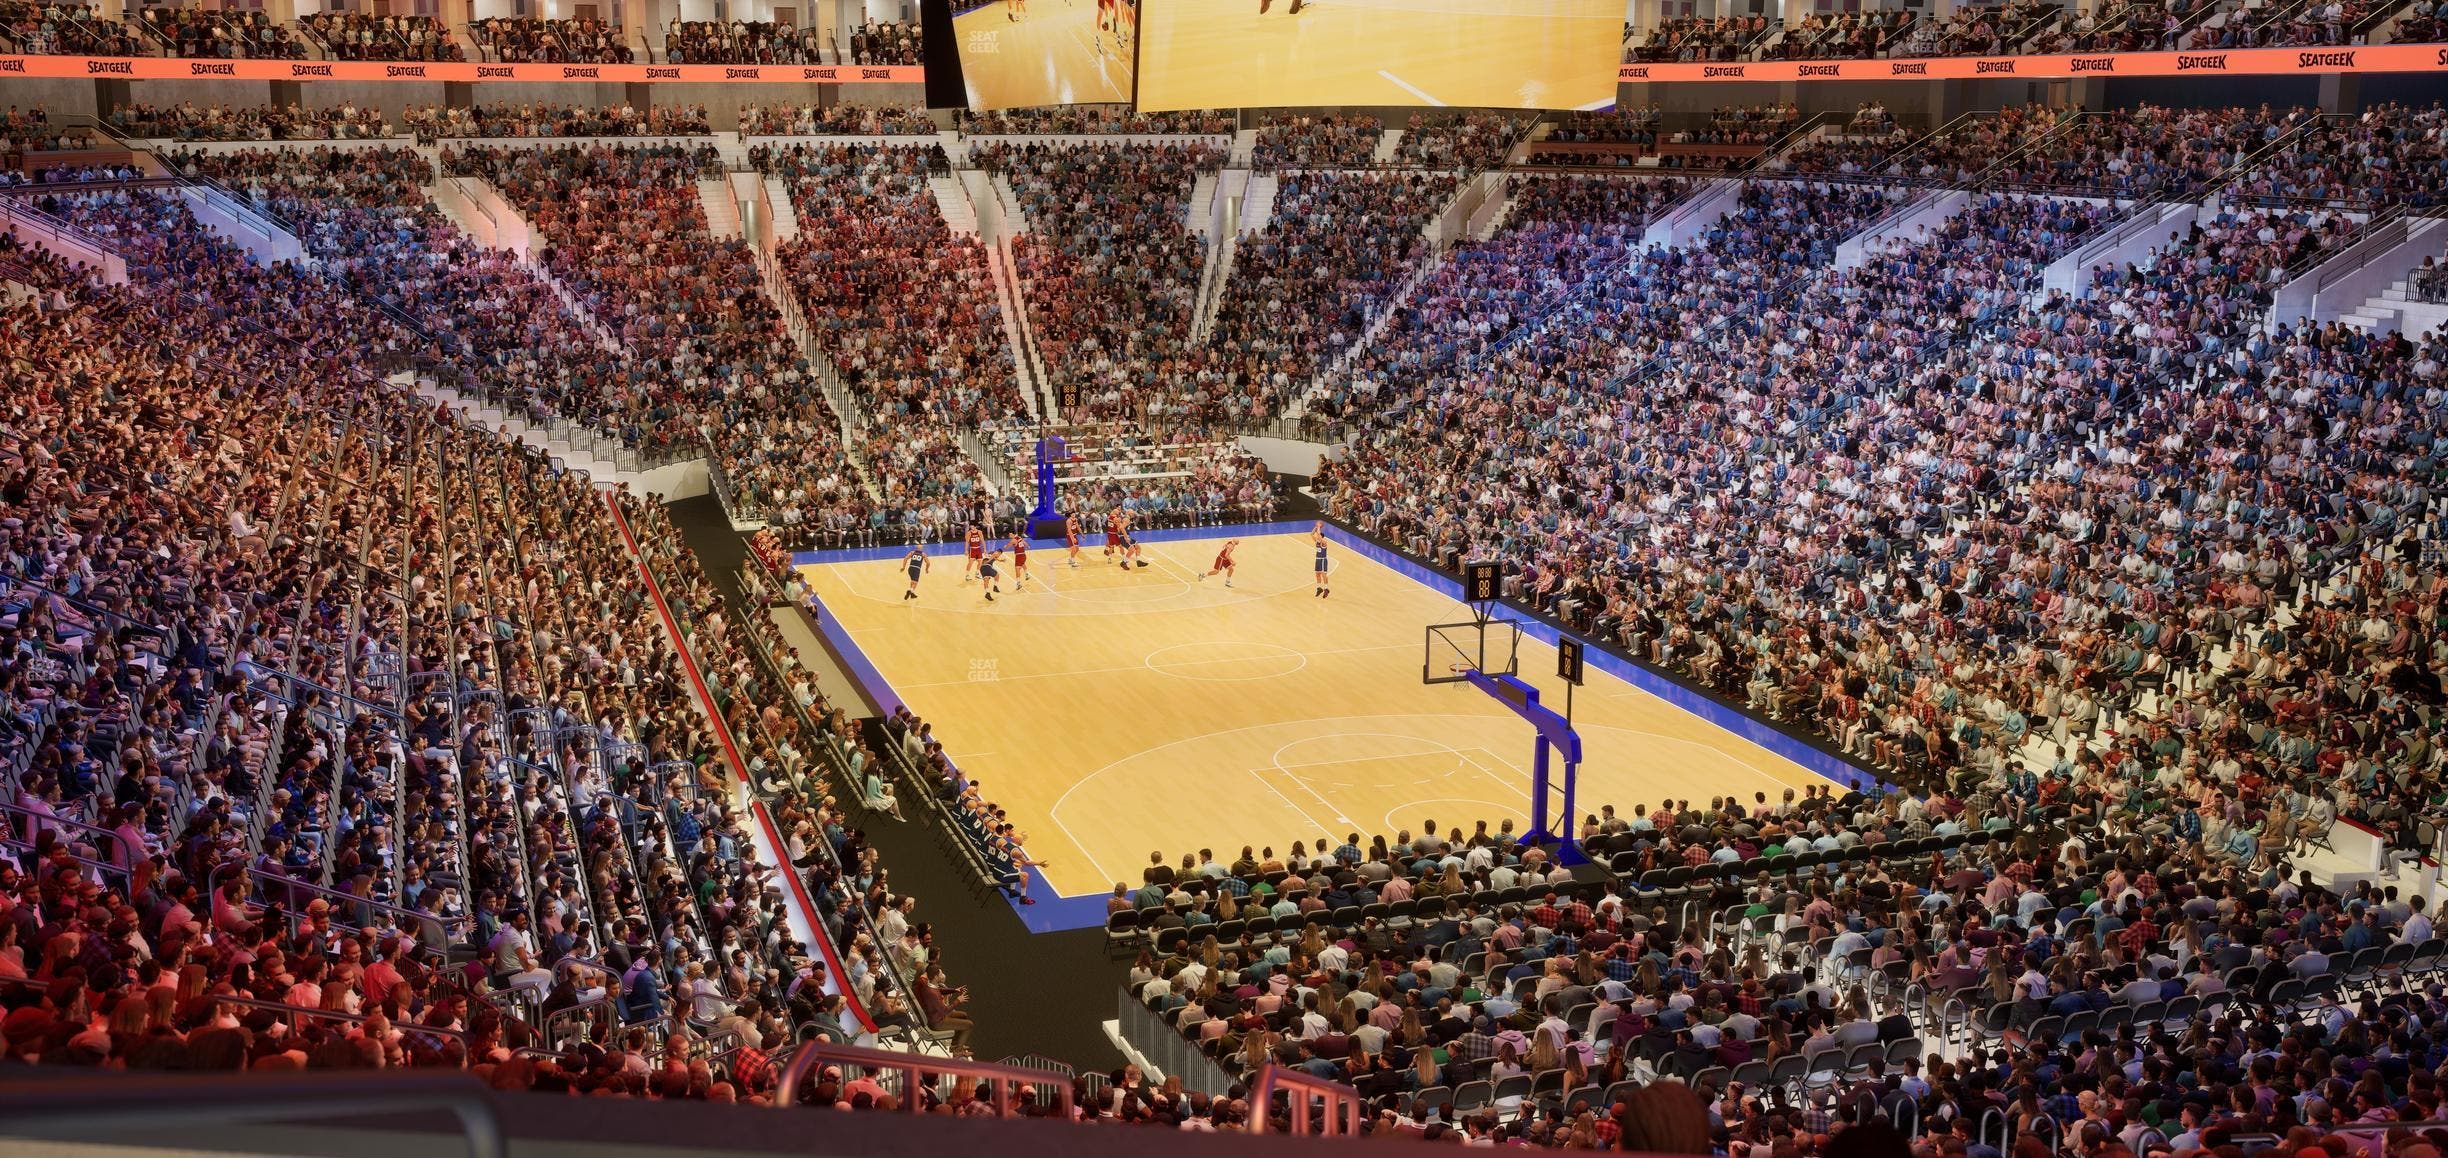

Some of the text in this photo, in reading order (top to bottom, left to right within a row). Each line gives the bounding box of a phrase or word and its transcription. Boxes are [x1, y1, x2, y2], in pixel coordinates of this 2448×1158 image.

[2071, 57, 2114, 72] SEATGEEK
[2177, 54, 2227, 70] SEATGEEK
[2299, 51, 2356, 68] SEATGEEK
[87, 61, 133, 74] SEATGEEK
[191, 63, 235, 75] SEATGEEK
[292, 64, 333, 76] SEATGEEK
[387, 65, 426, 77] SEATGEEK
[477, 67, 514, 77] SEATGEEK
[563, 67, 599, 78] SEATGEEK
[646, 68, 680, 78] SEATGEEK
[726, 68, 759, 78] SEATGEEK
[1704, 66, 1744, 77] SEATGEEK
[1798, 64, 1840, 76] SEATGEEK
[1892, 62, 1927, 75] SEATGEEK
[1976, 60, 2015, 74] SEATGEEK
[804, 69, 837, 79] SEATGEEK
[862, 69, 890, 79] SEATGEEK
